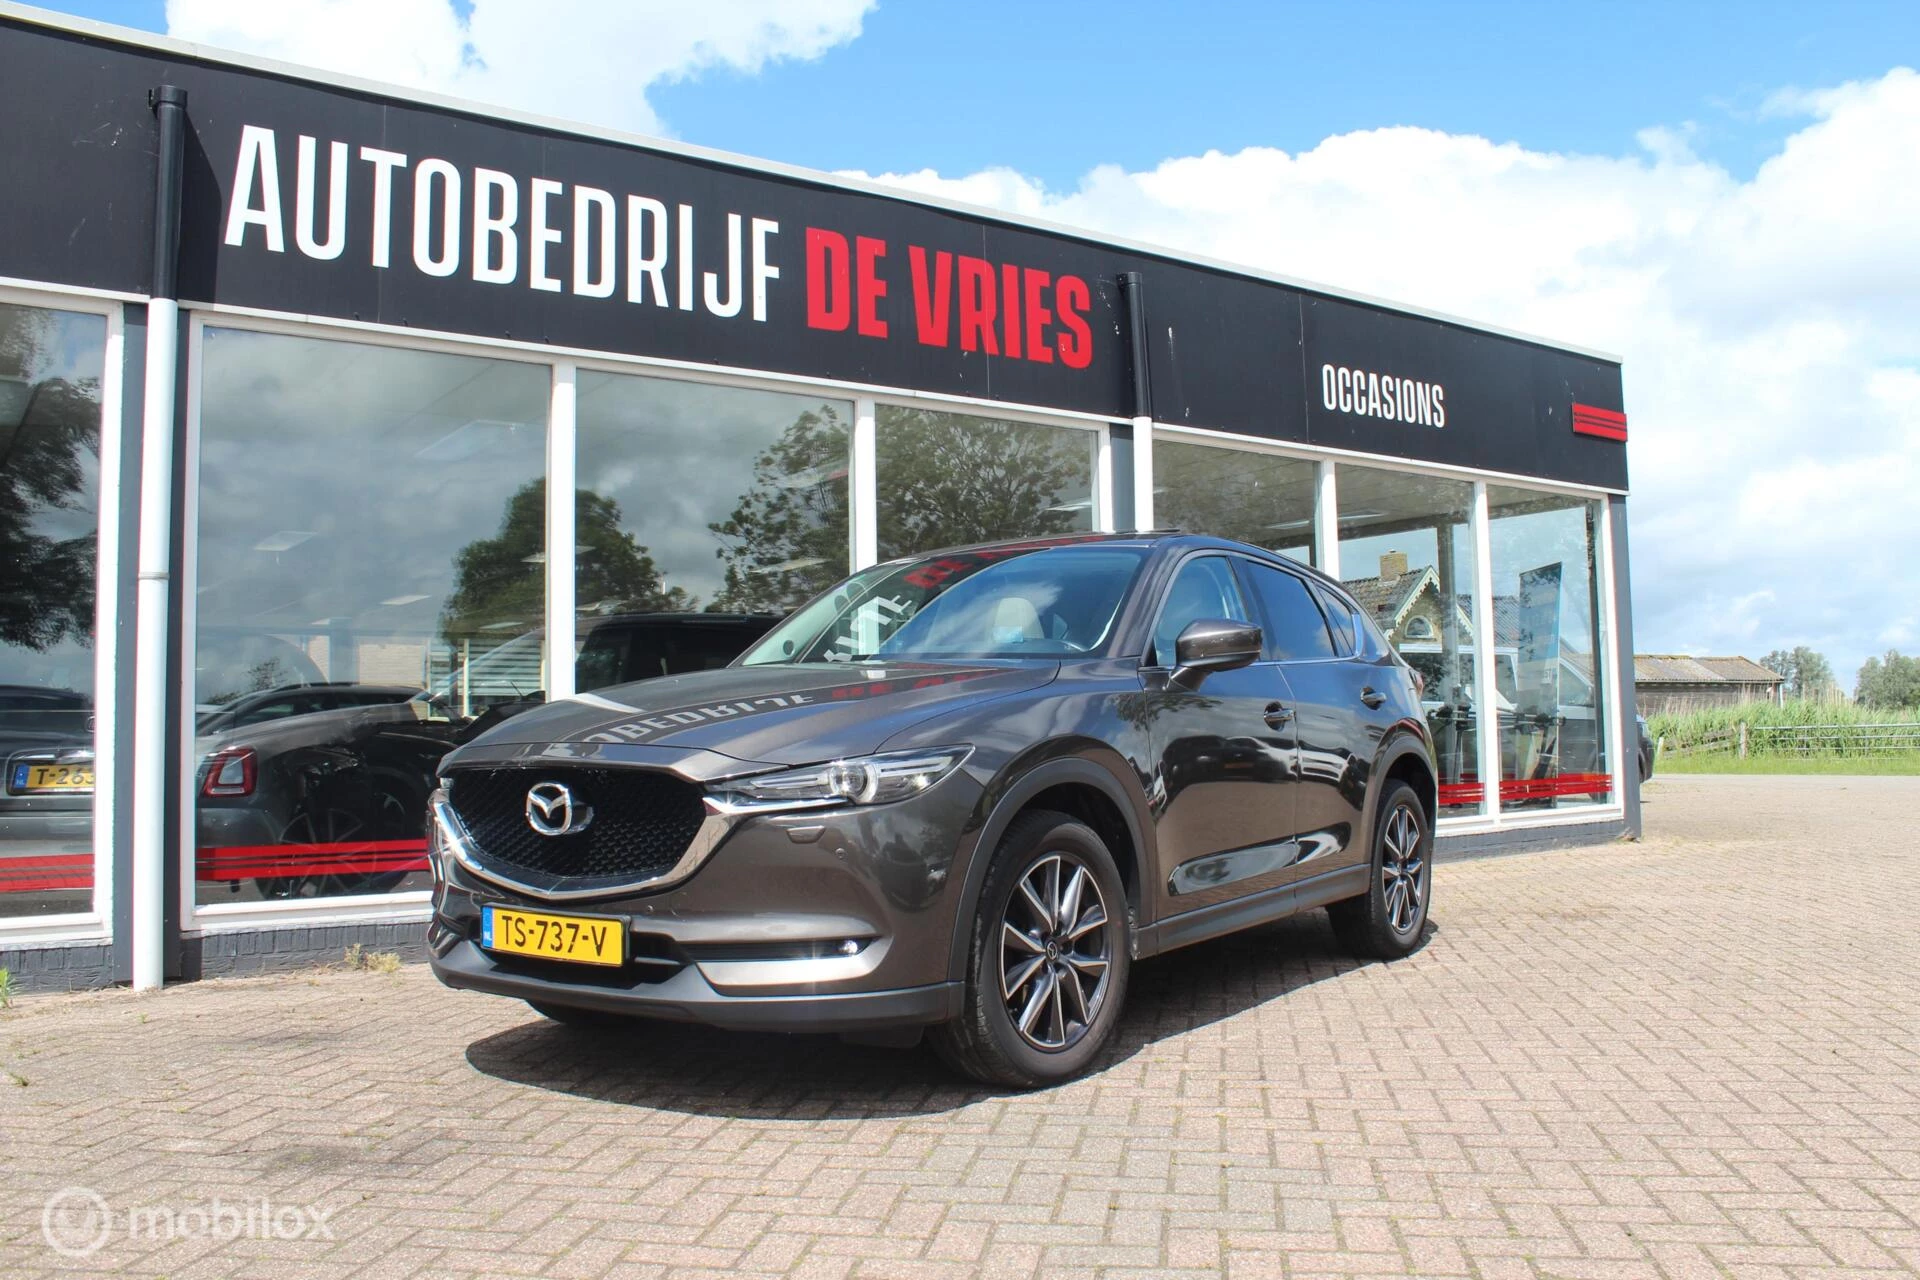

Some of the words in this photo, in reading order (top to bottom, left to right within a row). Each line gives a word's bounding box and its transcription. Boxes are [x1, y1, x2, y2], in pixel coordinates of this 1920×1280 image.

[223, 124, 781, 322] AUTOBEDRIJF
[805, 226, 888, 339] DE
[908, 245, 1093, 369] VRIES
[1322, 363, 1446, 428] OCCASIONS
[501, 915, 607, 957] TS-737-V
